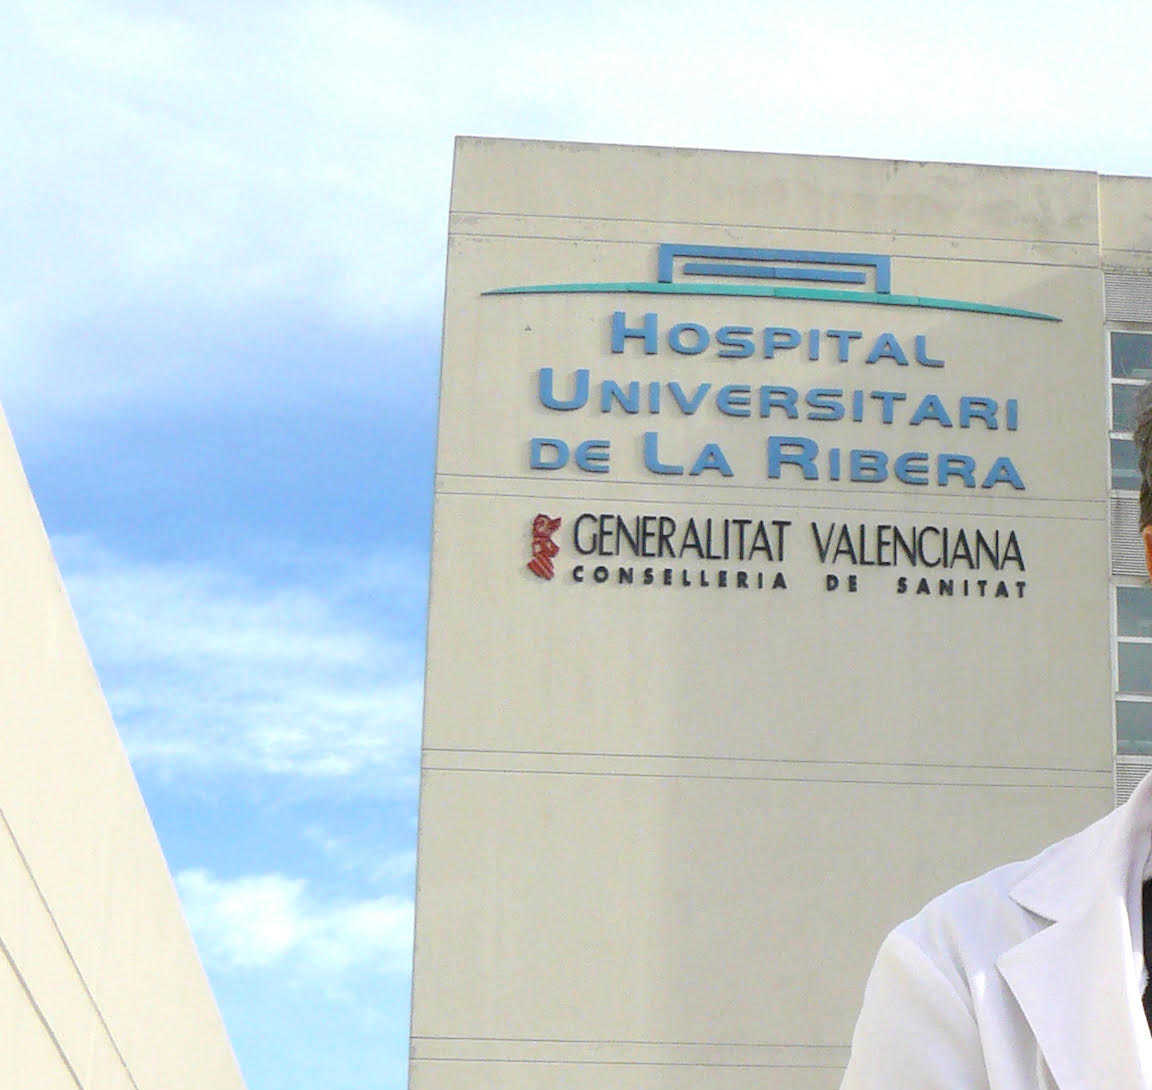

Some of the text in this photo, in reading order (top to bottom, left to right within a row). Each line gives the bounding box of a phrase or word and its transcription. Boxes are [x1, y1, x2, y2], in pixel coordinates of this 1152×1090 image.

[610, 311, 945, 368] HOSPITAL
[539, 368, 1018, 431] UNIVERSITARI
[529, 431, 1027, 491] DE LA RIBERA
[573, 513, 1026, 572] GENERALITAT VALENCIANA
[572, 566, 1027, 599] CONSELLERIA DE SANITAT
